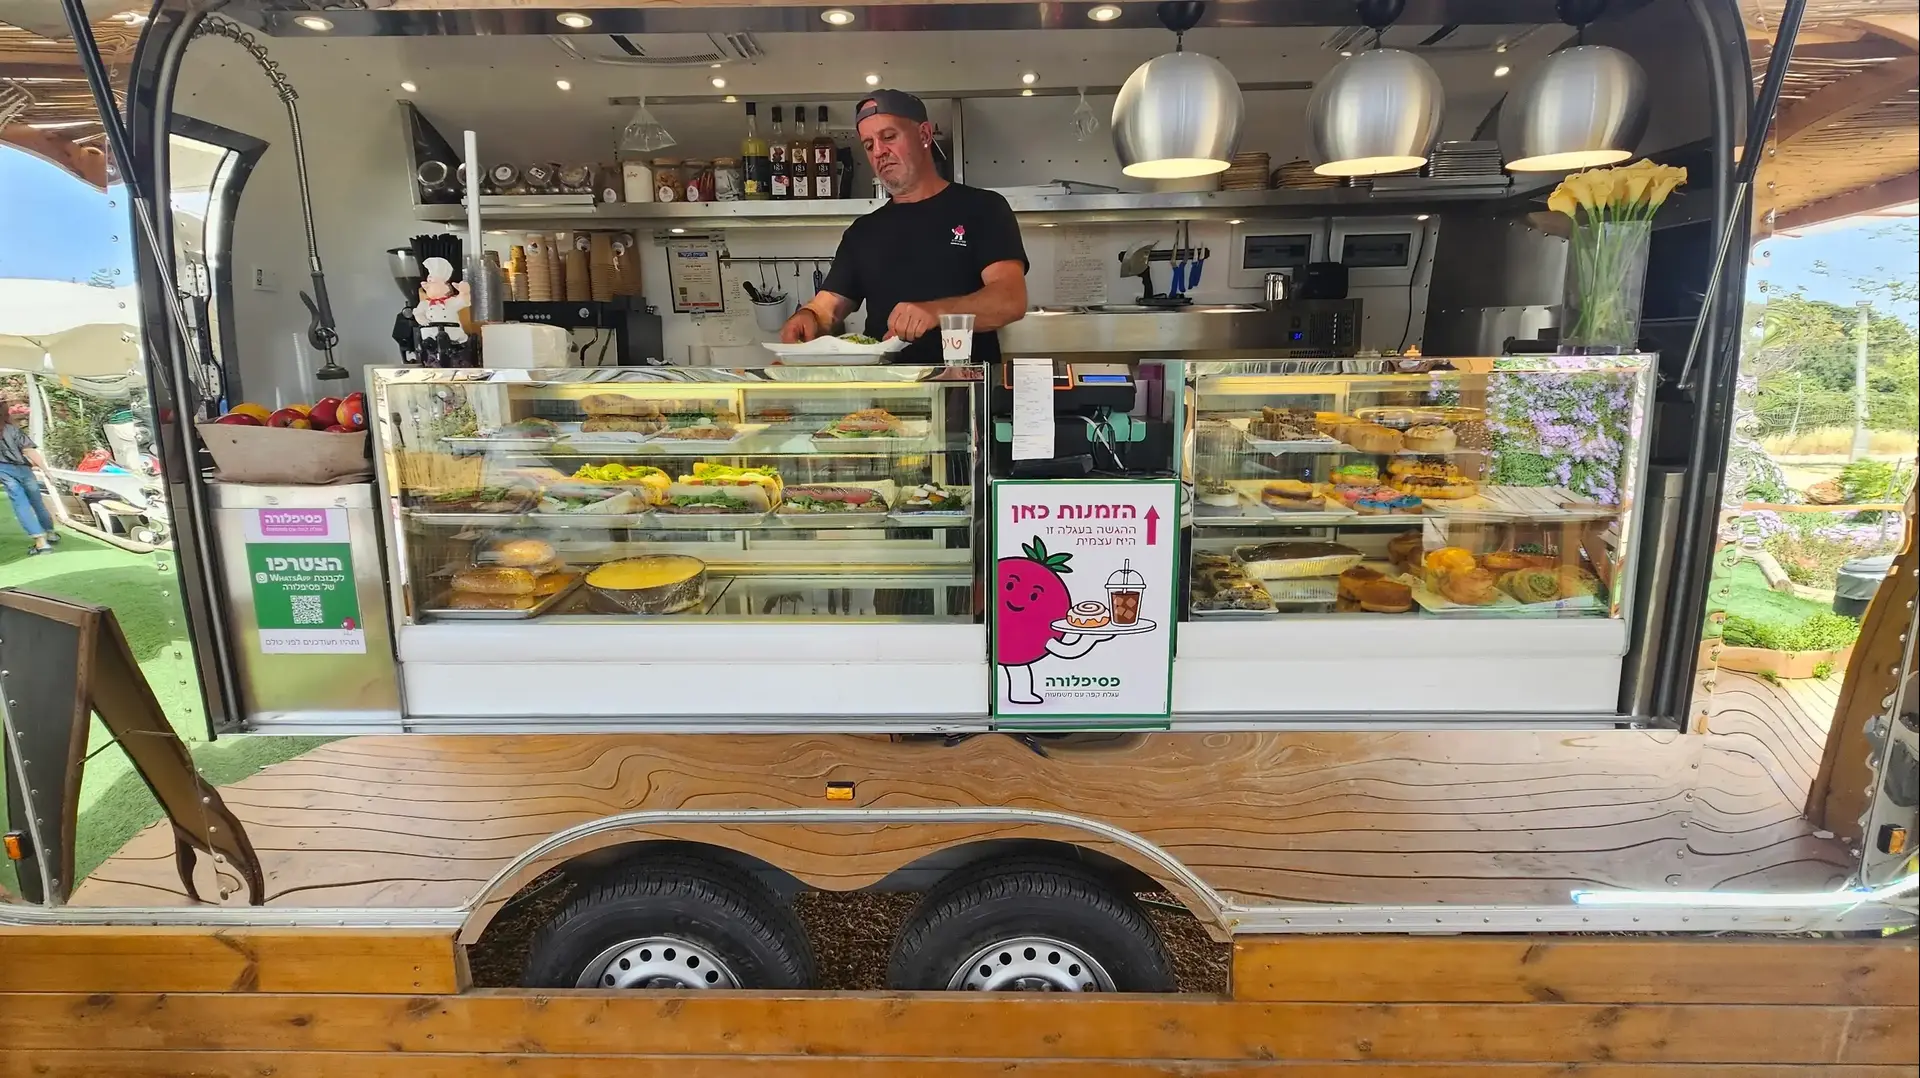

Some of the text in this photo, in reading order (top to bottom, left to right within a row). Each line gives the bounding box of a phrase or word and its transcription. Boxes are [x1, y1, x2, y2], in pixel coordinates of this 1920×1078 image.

[264, 513, 322, 524] פסיפלורה
[1011, 504, 1136, 523] הזמנות כאן
[1046, 525, 1137, 535] ההגשה בעגלה זו
[1075, 537, 1136, 546] היא עצמית
[265, 557, 343, 571] הצטרפו
[313, 573, 345, 583] לקבוצת
[282, 583, 321, 591] פסיפלורה
[265, 638, 283, 646] כולם
[285, 638, 300, 646] לפני
[1045, 675, 1121, 687] פסיפלורה
